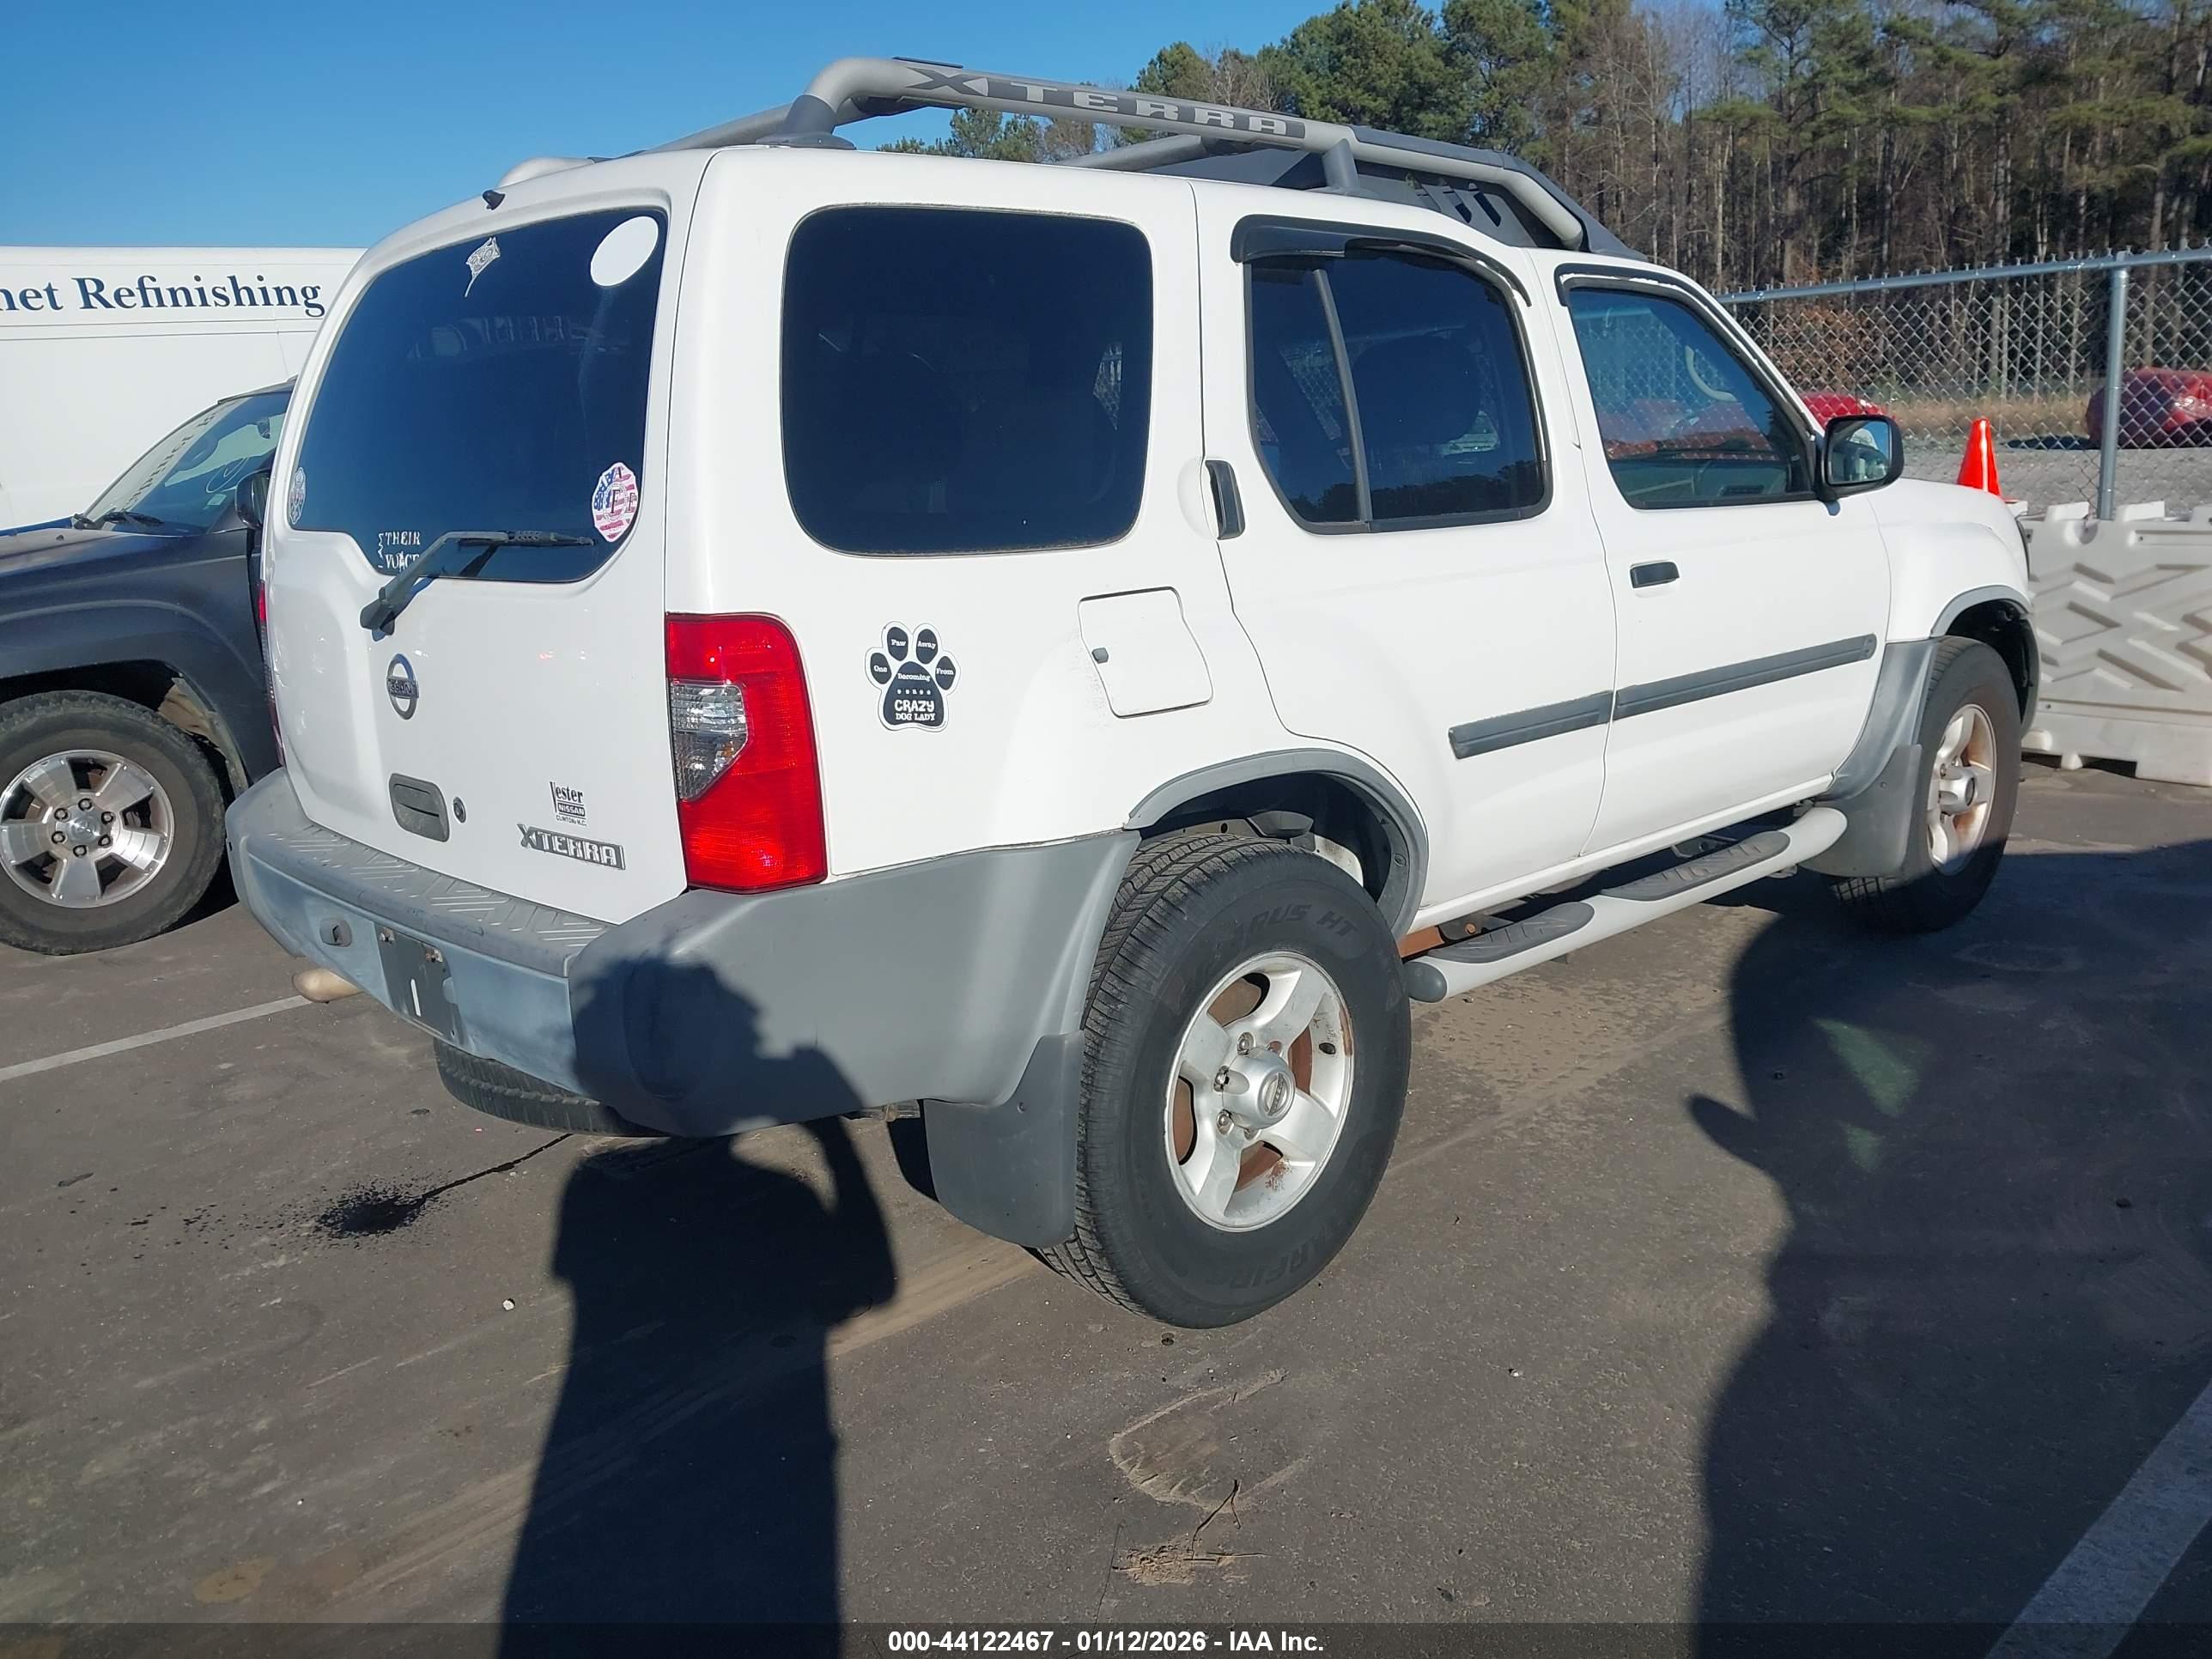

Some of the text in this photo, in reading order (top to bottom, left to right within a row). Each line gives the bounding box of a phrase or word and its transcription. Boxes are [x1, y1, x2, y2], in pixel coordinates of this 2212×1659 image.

[906, 66, 1287, 136] XTERRA
[71, 275, 325, 318] Refinishing
[385, 531, 421, 546] THEIR
[873, 665, 888, 673] One
[890, 638, 907, 647] Paw
[917, 640, 936, 649] Away
[897, 673, 931, 682] Becoming
[894, 699, 935, 712] CRAZY
[895, 713, 936, 721] DOG LADY
[558, 802, 586, 817] NISSAN
[517, 823, 618, 866] XTERRA
